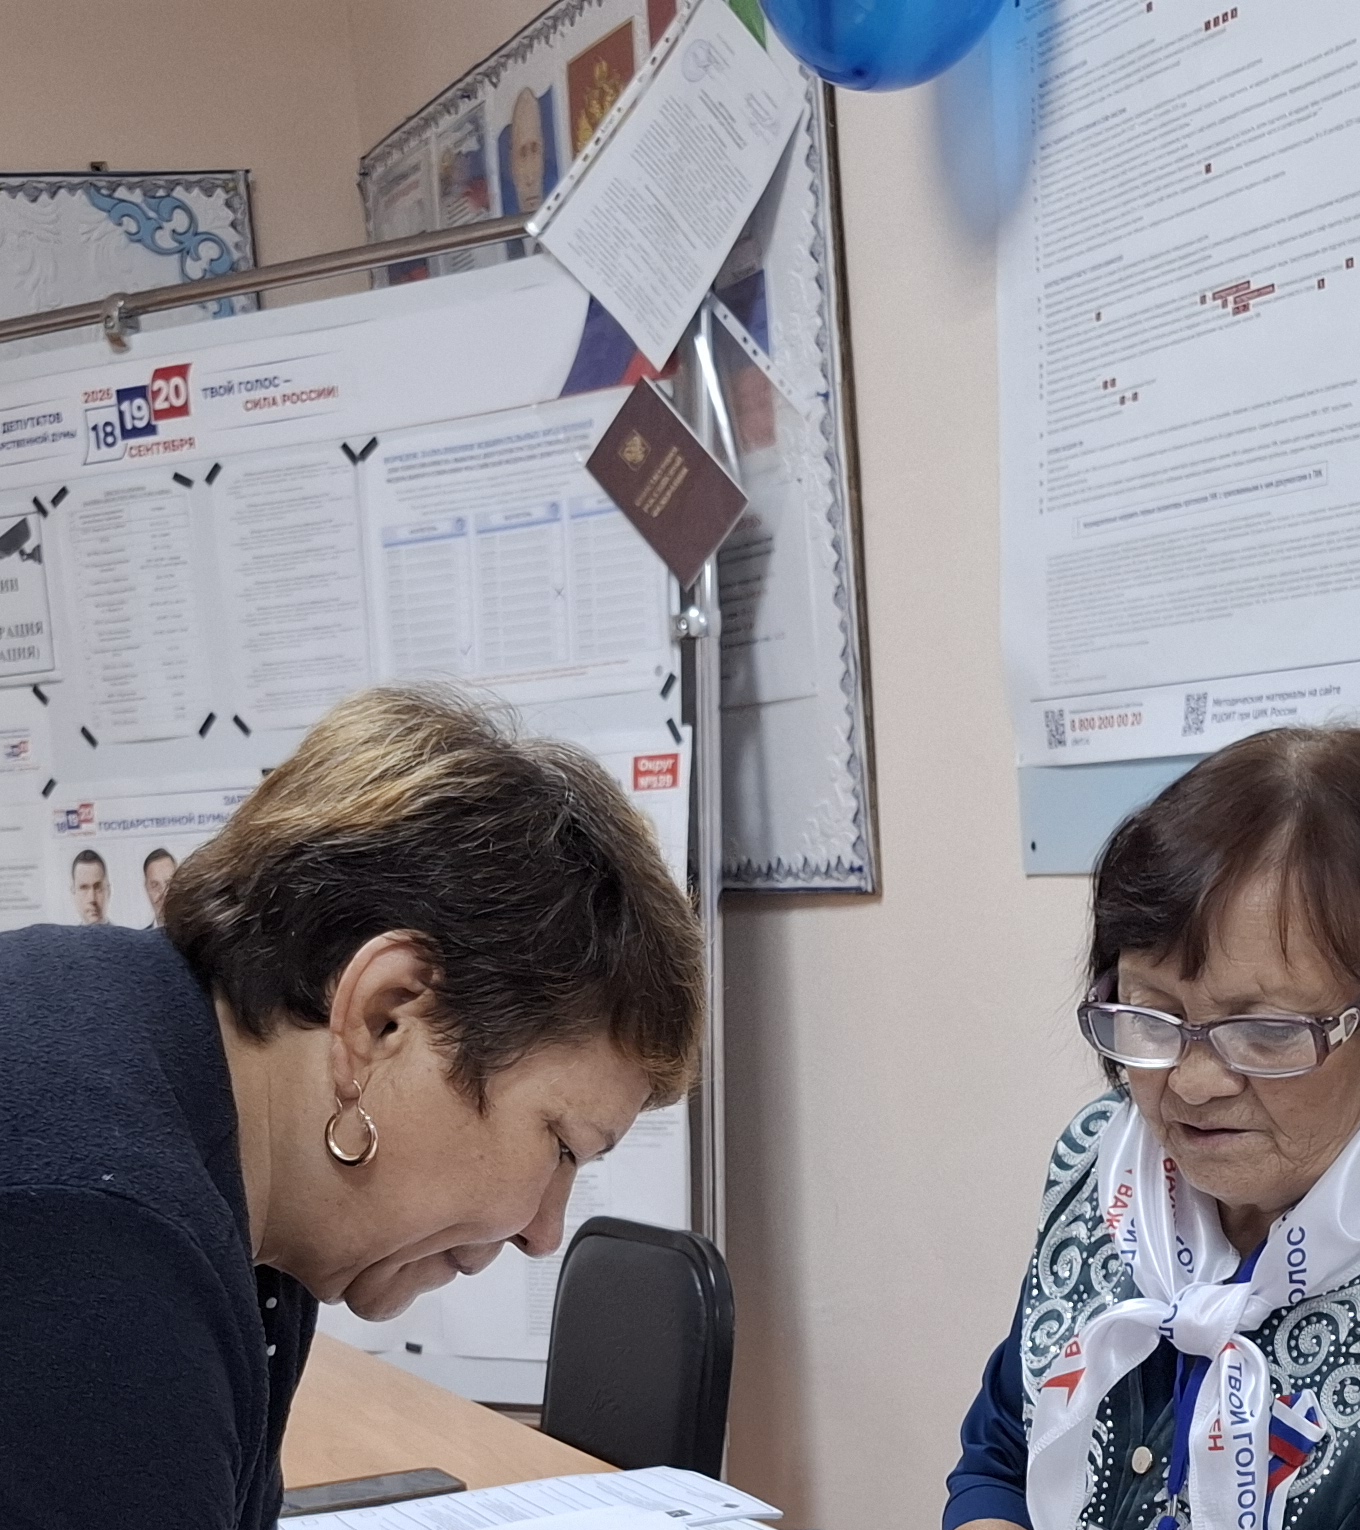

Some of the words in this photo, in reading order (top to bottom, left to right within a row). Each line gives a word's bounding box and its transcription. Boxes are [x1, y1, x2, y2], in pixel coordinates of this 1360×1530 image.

[152, 376, 188, 411] 20
[202, 380, 235, 399] ТВОЙ
[239, 377, 280, 394] ГОЛОС
[120, 399, 150, 430] 19
[243, 397, 277, 412] СИЛА
[3, 412, 63, 433] ДЕПУТАТОВ
[91, 421, 117, 450] 18
[128, 437, 196, 458] СЕНТЯБРЯ
[1097, 714, 1115, 730] 200
[1130, 711, 1142, 726] 20
[98, 812, 195, 831] ГОСУДАРСТВЕННОЙ
[1227, 1361, 1255, 1428] ТВОЙ
